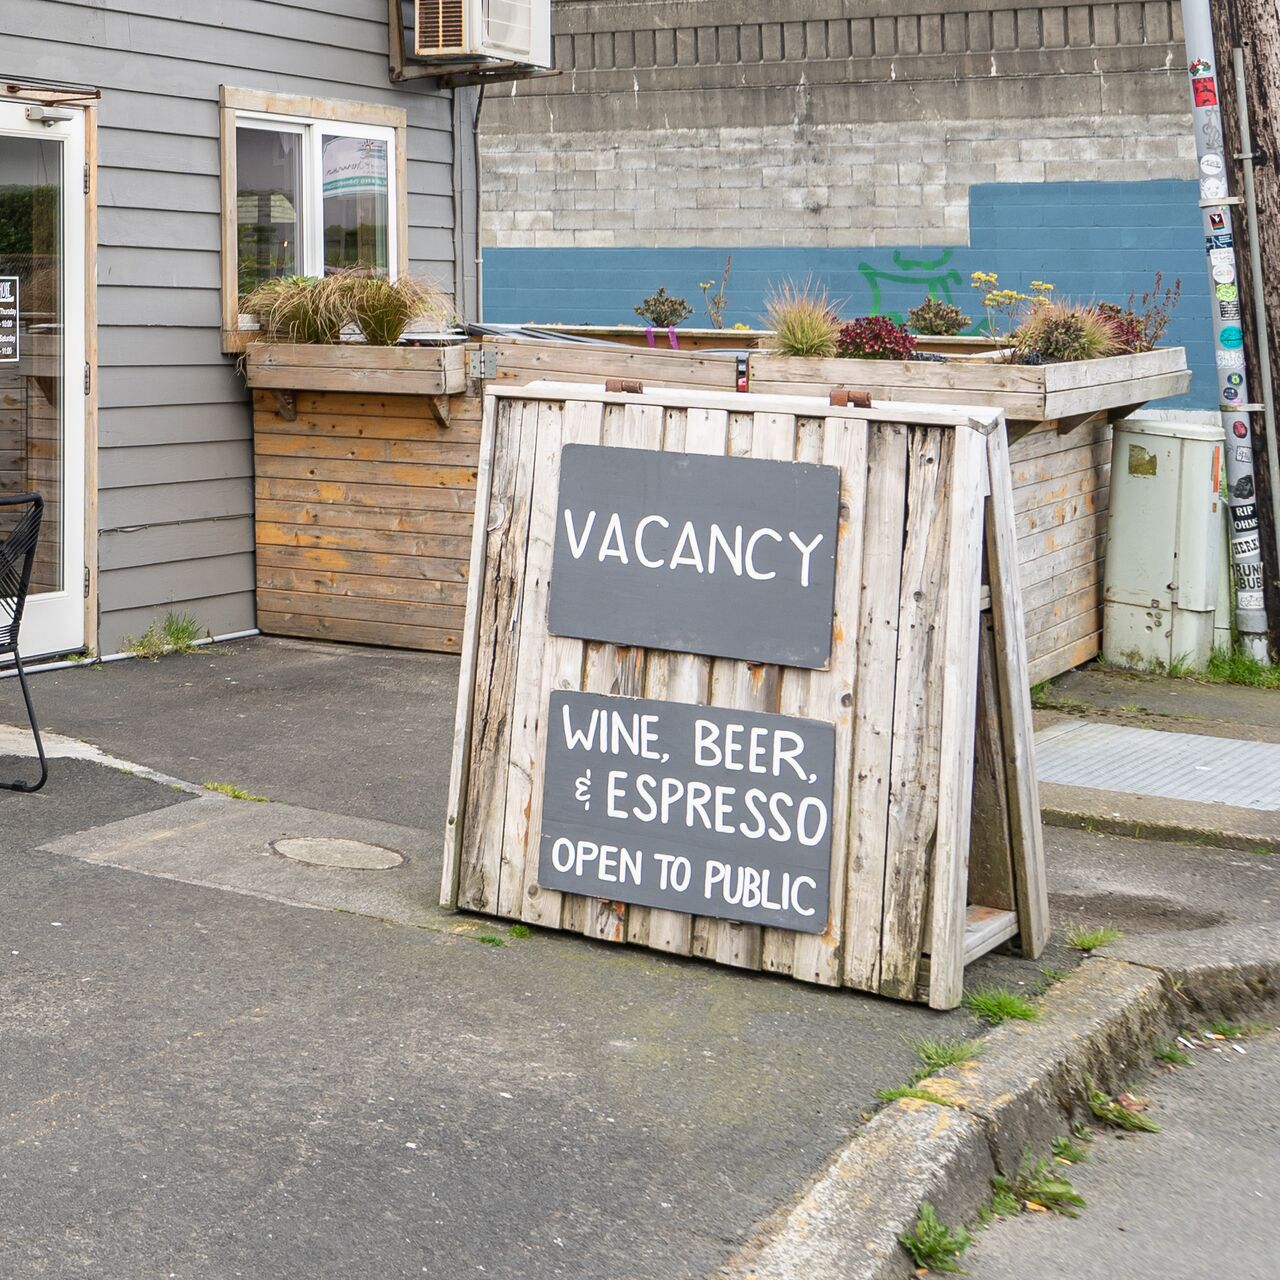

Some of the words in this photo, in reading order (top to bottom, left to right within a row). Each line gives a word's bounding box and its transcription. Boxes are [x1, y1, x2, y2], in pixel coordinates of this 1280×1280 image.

[564, 508, 824, 587] VACANCY
[1235, 506, 1254, 517] RIP
[562, 704, 670, 763] WINE,
[694, 719, 818, 784] BEER,
[607, 770, 828, 846] ESPRESSO
[552, 837, 642, 886] OPEN
[654, 853, 691, 892] TO
[704, 860, 817, 916] PUBLIC
